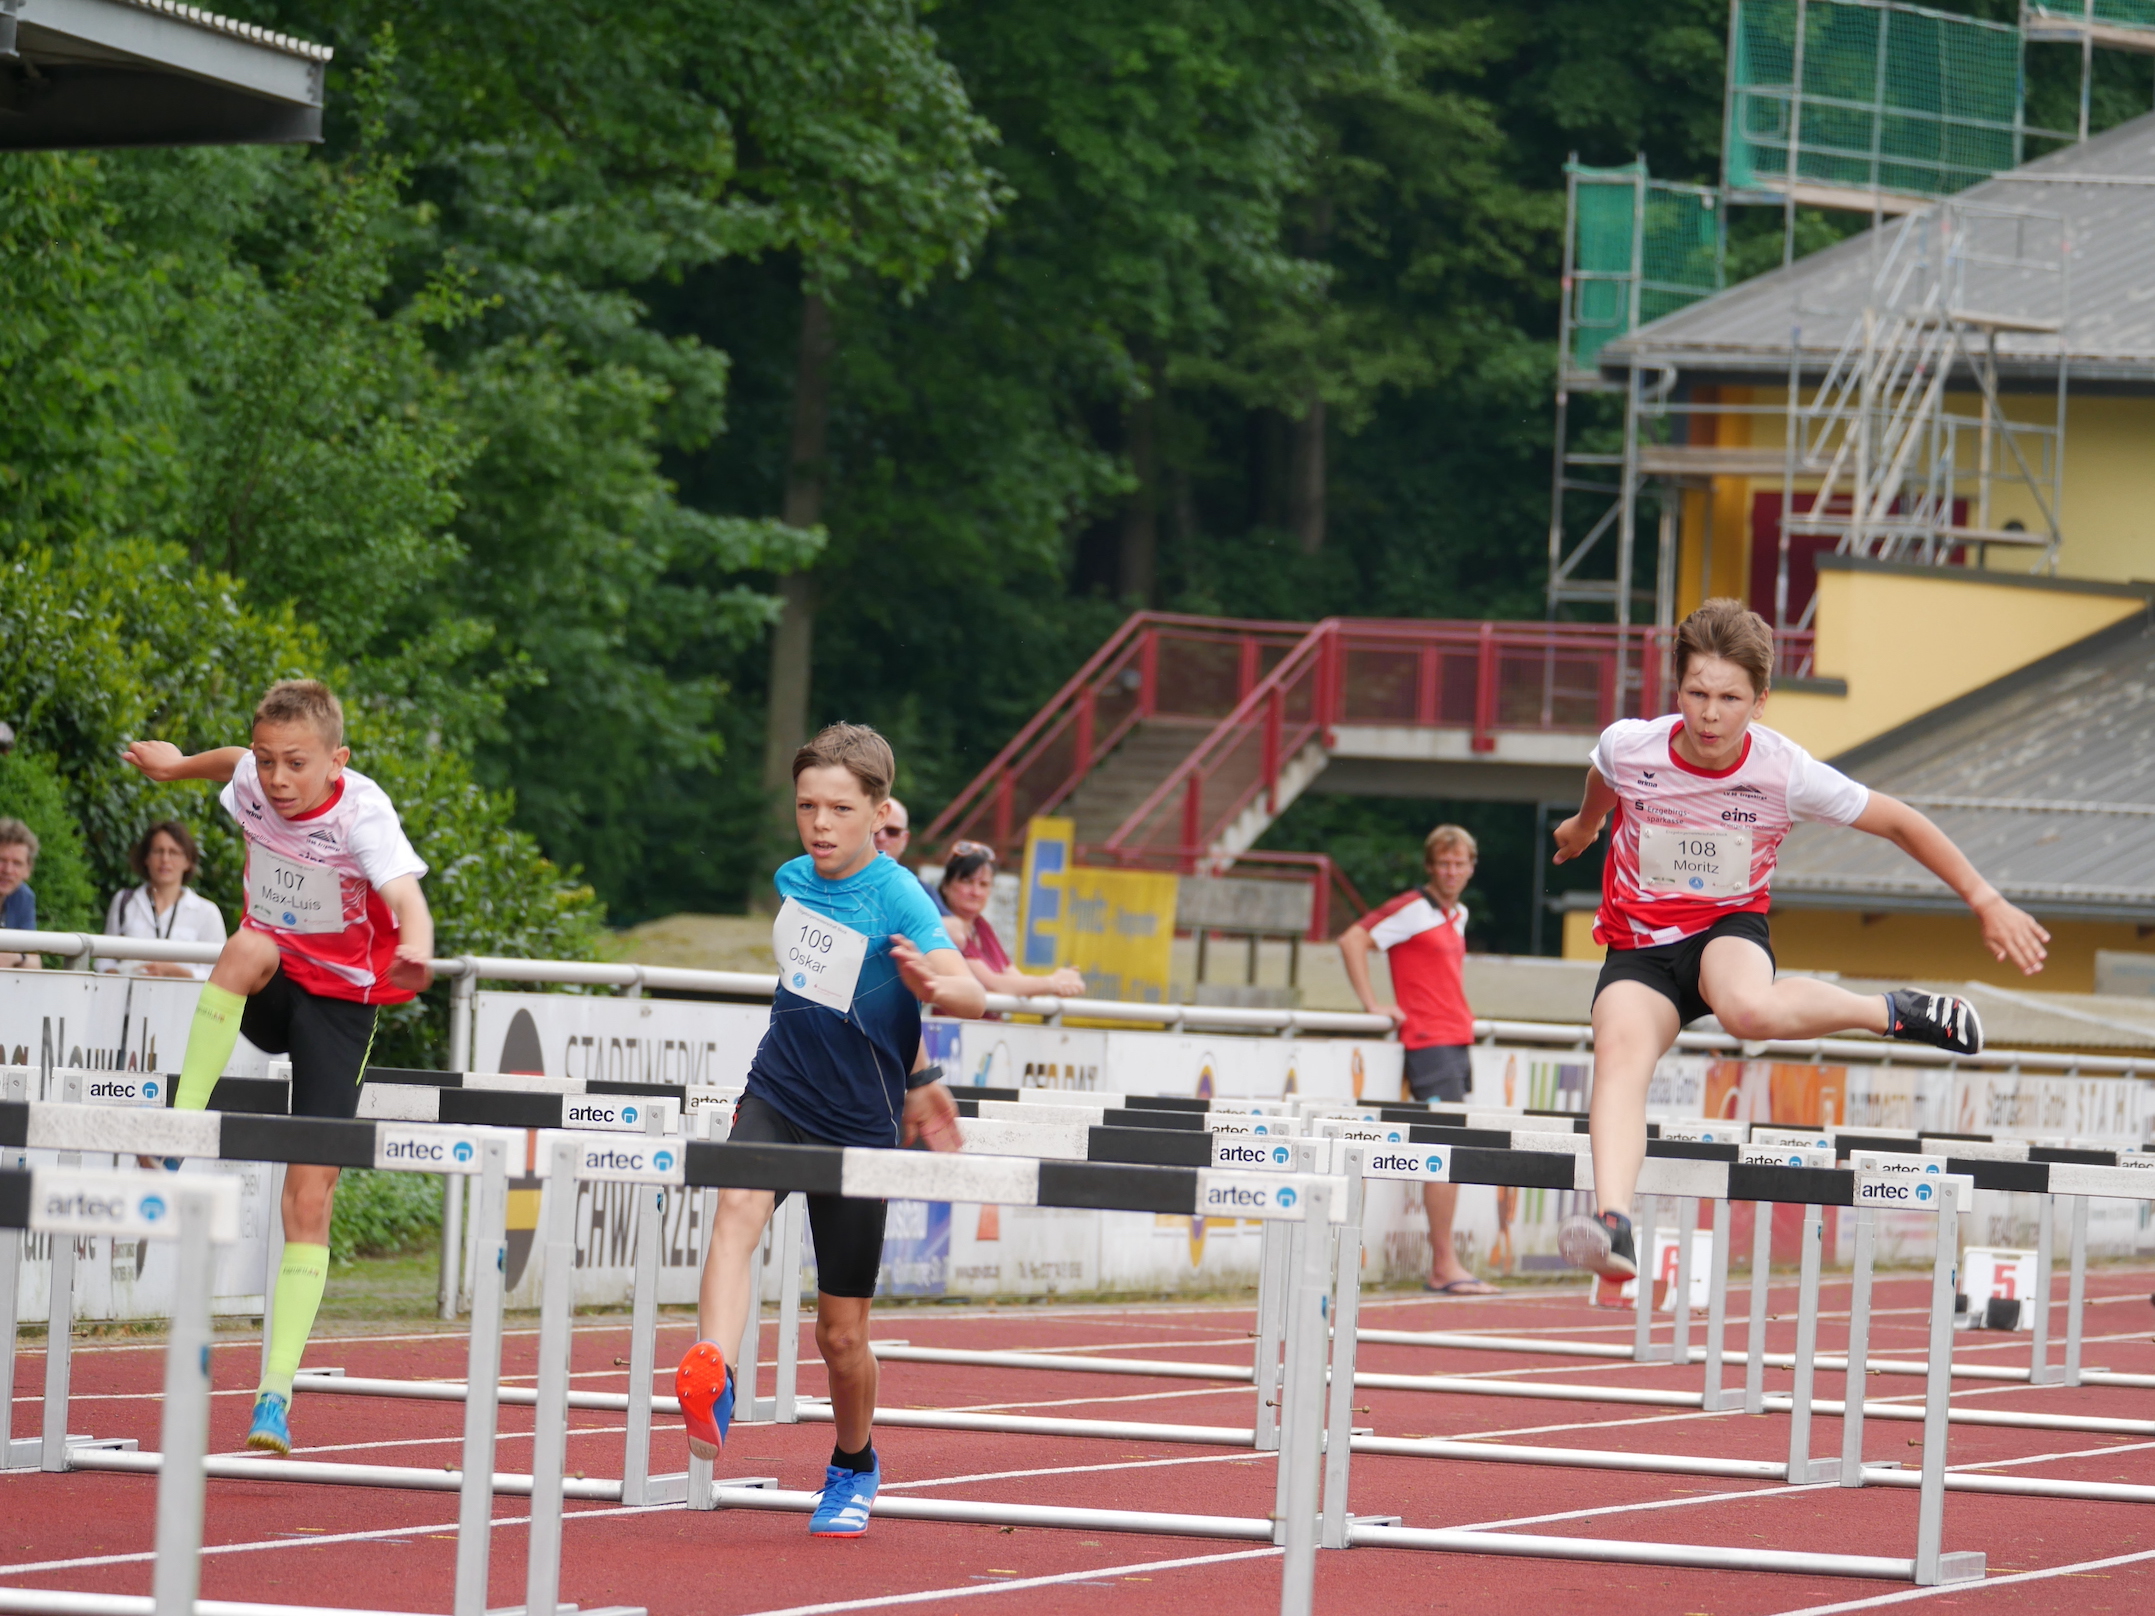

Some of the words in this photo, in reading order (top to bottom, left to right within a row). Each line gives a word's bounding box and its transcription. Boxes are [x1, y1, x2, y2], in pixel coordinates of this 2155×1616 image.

[1647, 806, 1690, 817] Erzgebirgs-
[1647, 816, 1684, 824] sparkasse
[1721, 807, 1757, 823] eins
[1678, 840, 1716, 857] 108
[1674, 859, 1719, 874] Moritz
[275, 867, 305, 891] 107
[262, 885, 321, 911] Max-Luis
[800, 924, 833, 953] 109
[789, 946, 827, 974] Oskar
[90, 1081, 135, 1098] artec
[568, 1105, 615, 1122] artec
[386, 1139, 444, 1160] artec
[1219, 1146, 1265, 1163] artec
[585, 1148, 643, 1170] artec
[1372, 1154, 1419, 1171] artec
[1207, 1186, 1266, 1207] artec
[1861, 1182, 1909, 1200] artec
[47, 1191, 125, 1218] artec
[1992, 1264, 2016, 1299] 5
